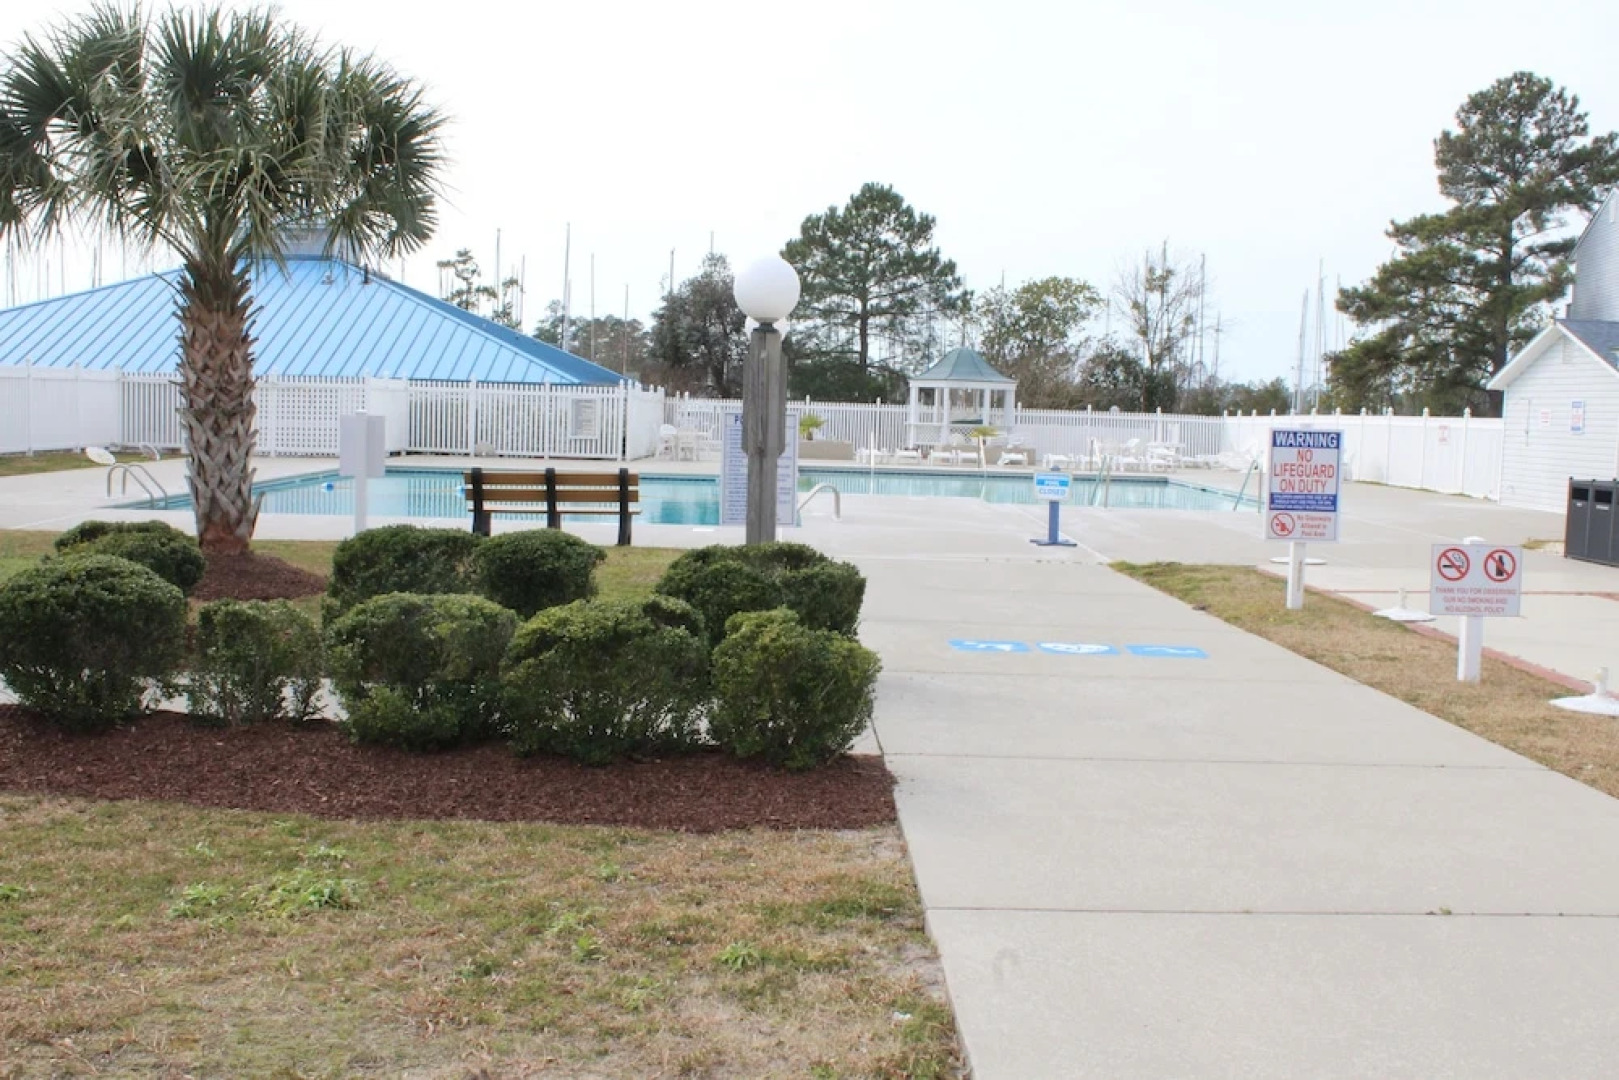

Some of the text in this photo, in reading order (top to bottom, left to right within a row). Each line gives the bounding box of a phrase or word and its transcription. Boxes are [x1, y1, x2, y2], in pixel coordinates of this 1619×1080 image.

[1275, 431, 1337, 448] WARNING
[1297, 449, 1313, 462] NO
[1273, 463, 1335, 478] LIFEGUARD
[1280, 479, 1327, 493] ON DUTY
